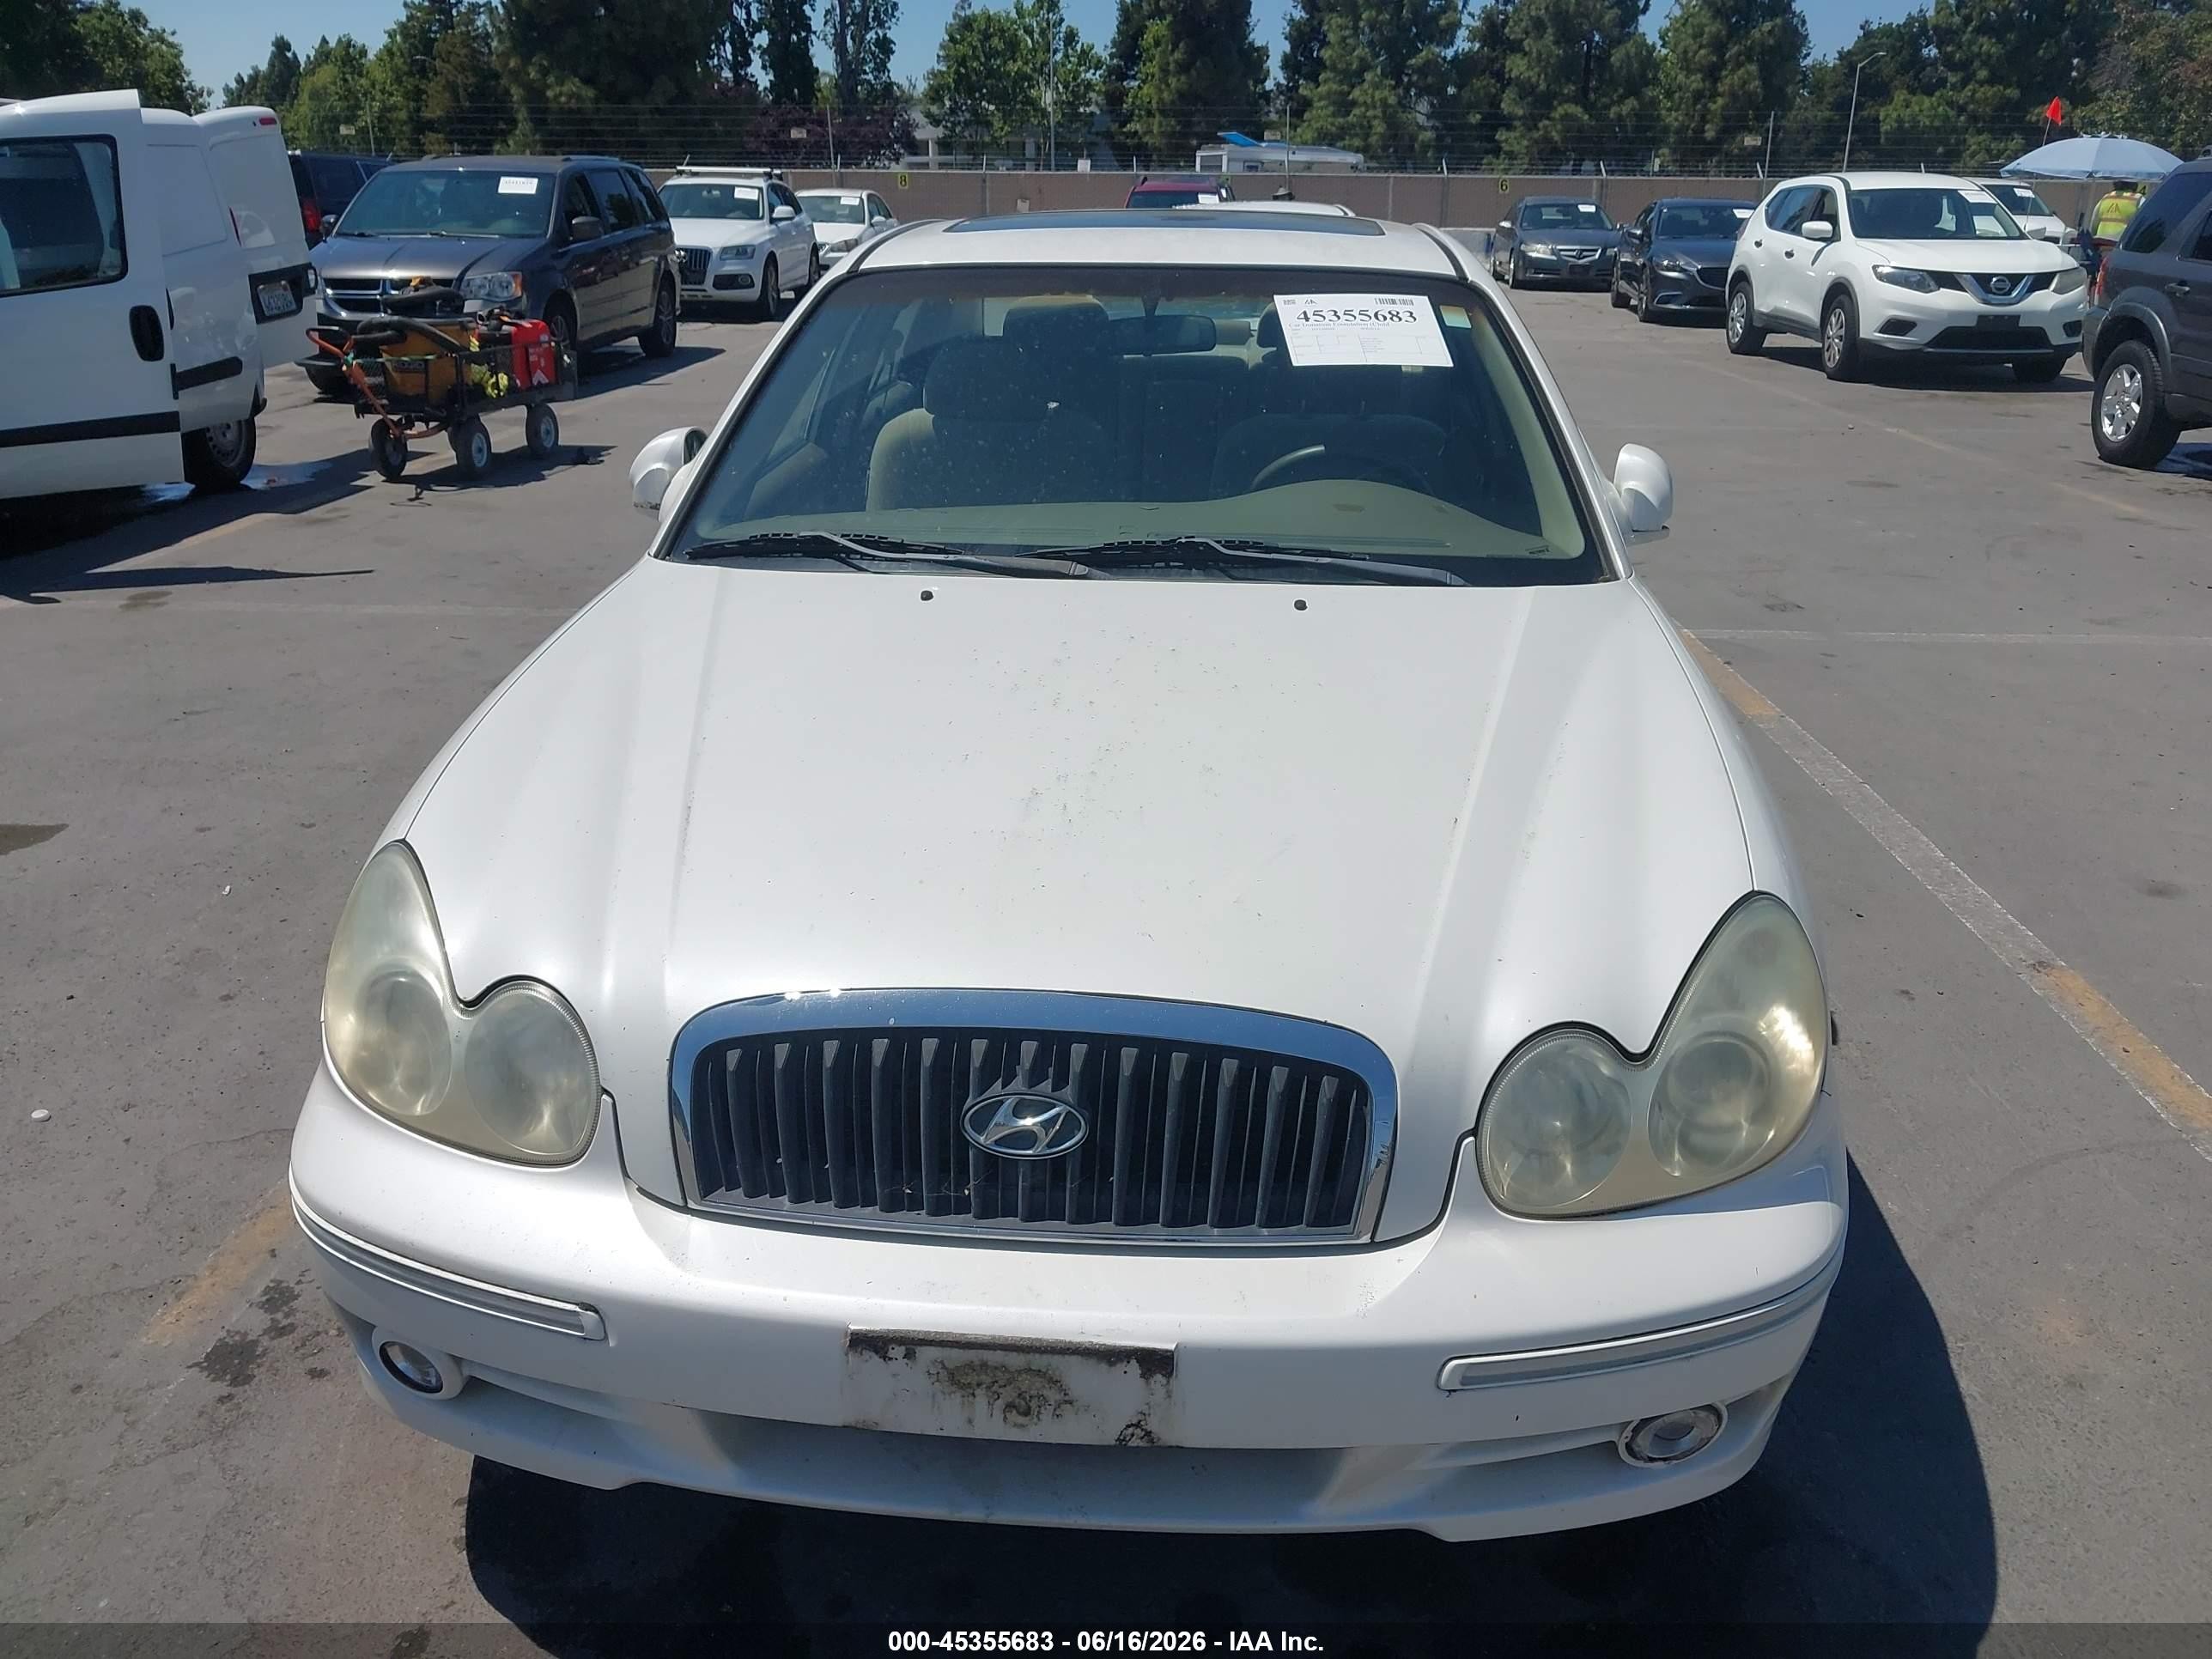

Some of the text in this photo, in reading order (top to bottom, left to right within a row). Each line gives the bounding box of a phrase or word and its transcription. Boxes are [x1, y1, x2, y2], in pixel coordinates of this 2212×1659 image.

[899, 174, 908, 187] 8
[1500, 179, 1509, 192] 6
[1297, 309, 1417, 324] 45355683
